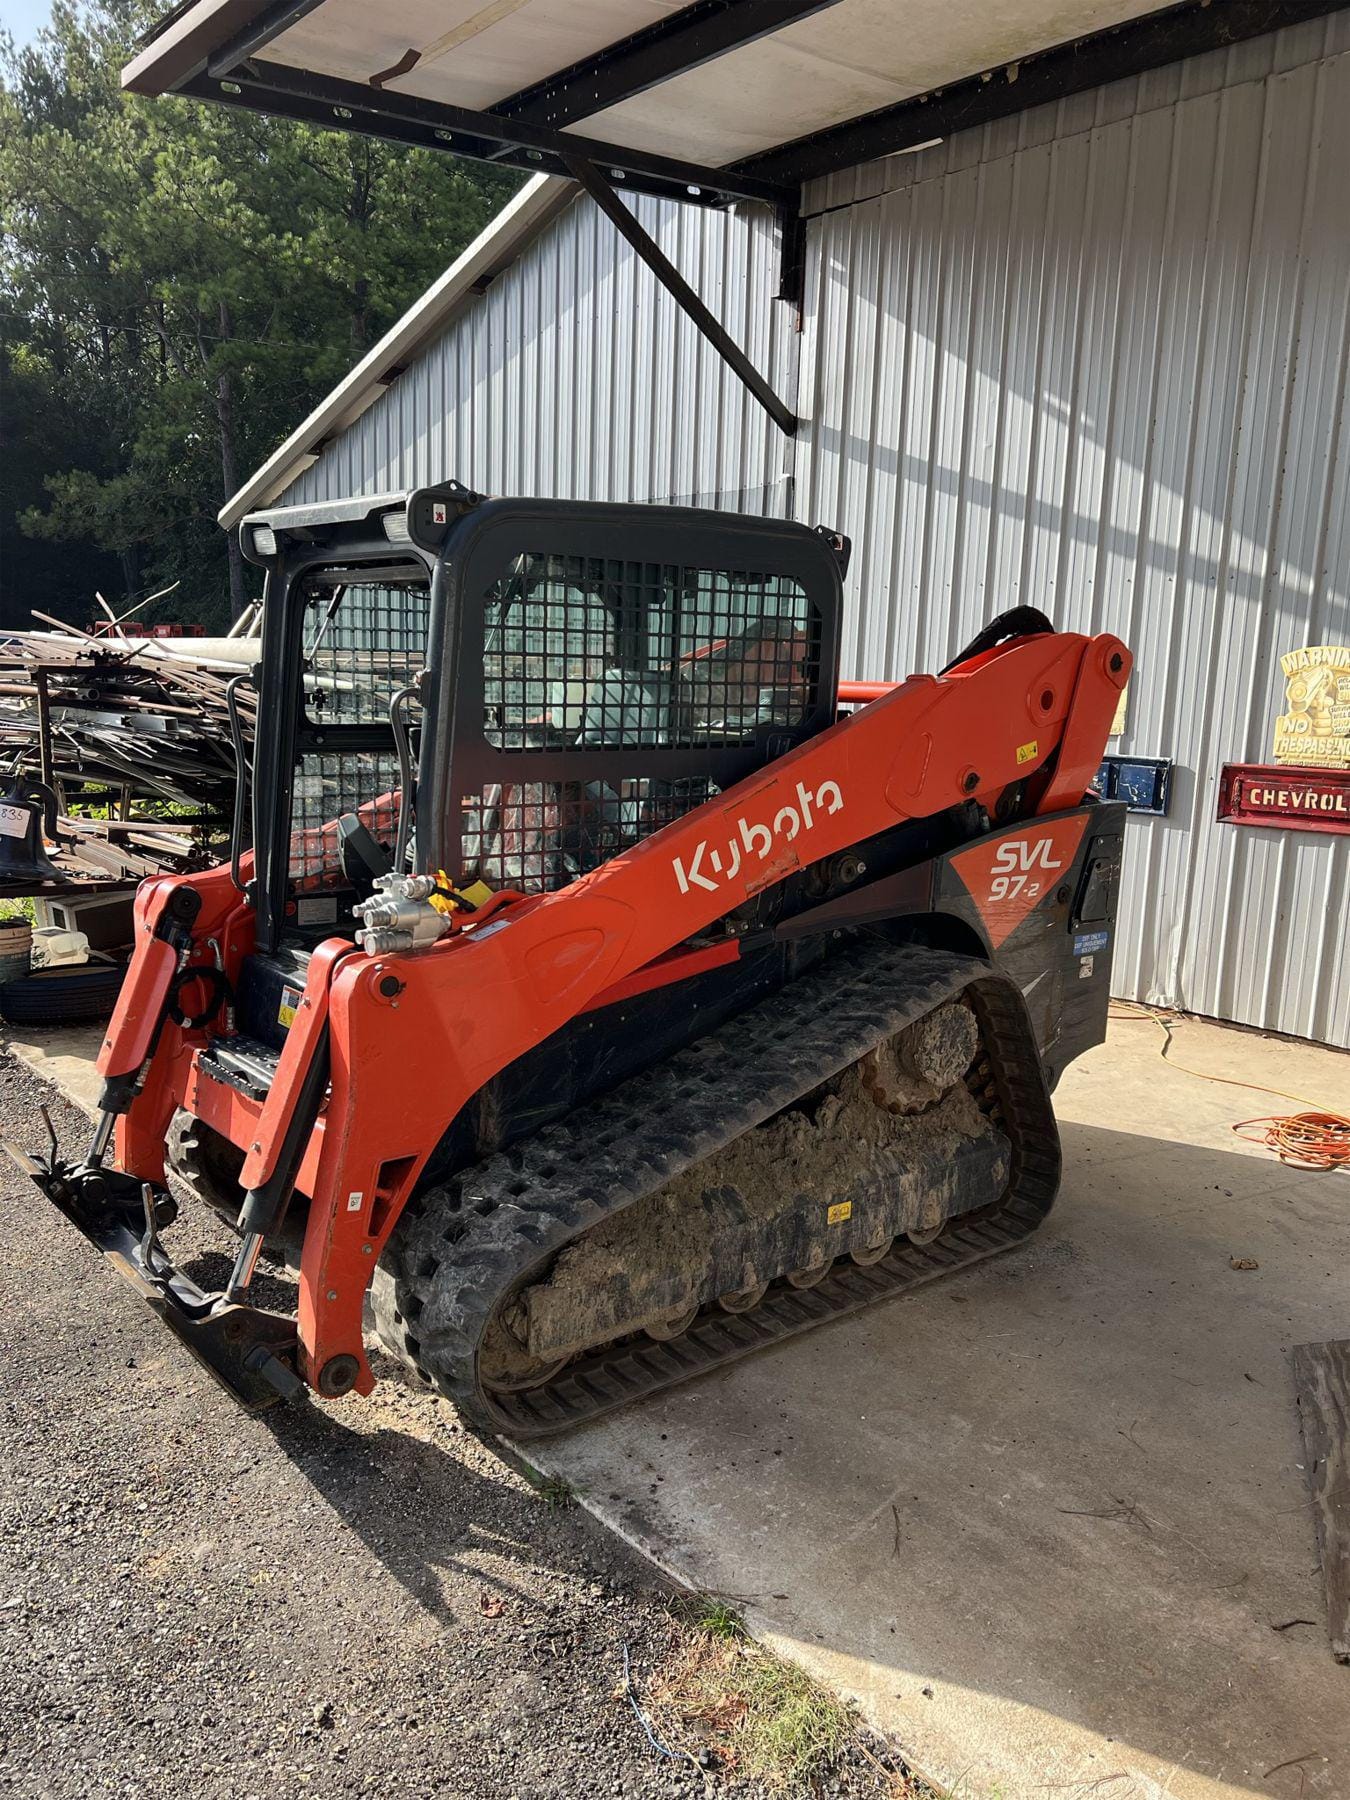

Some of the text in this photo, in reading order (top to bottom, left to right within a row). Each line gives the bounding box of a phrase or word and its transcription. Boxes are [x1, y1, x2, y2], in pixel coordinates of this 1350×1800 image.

[1282, 718, 1308, 734] NO
[1250, 788, 1348, 812] CHEVROL
[672, 780, 844, 895] Kubota
[991, 838, 1062, 874] SVL
[988, 875, 1040, 902] 97-2
